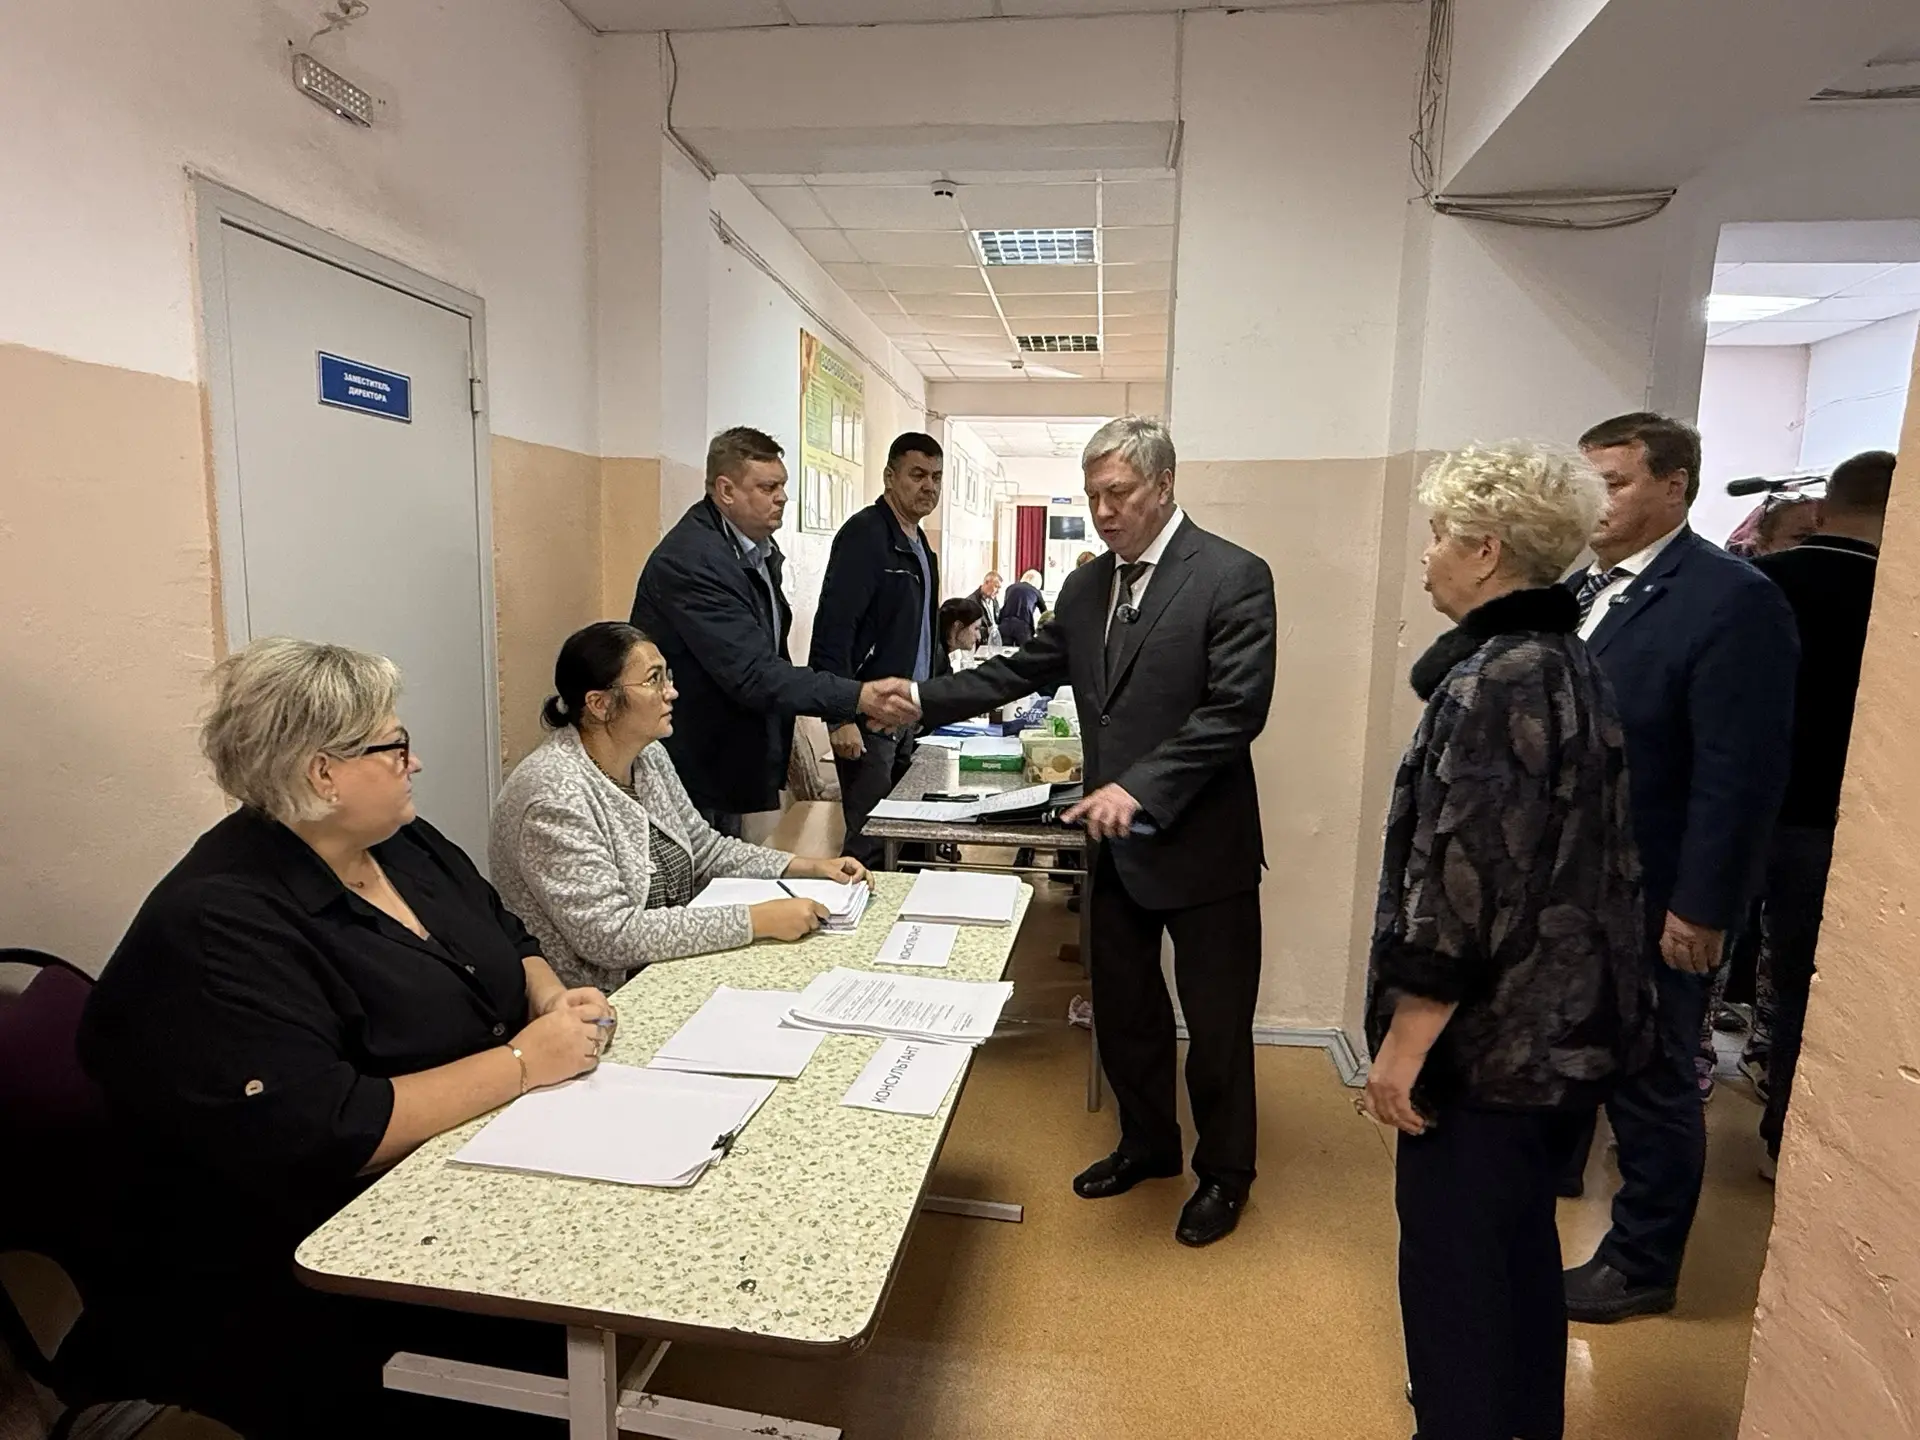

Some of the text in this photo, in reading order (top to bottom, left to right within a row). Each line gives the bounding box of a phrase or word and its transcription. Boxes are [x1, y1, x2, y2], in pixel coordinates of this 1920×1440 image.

[343, 372, 391, 392] ЗАМЕСТИТЕЛЬ
[348, 386, 388, 403] ДИРЕКТОРА
[871, 1044, 920, 1104] КОНСУЛЬТАНТ
